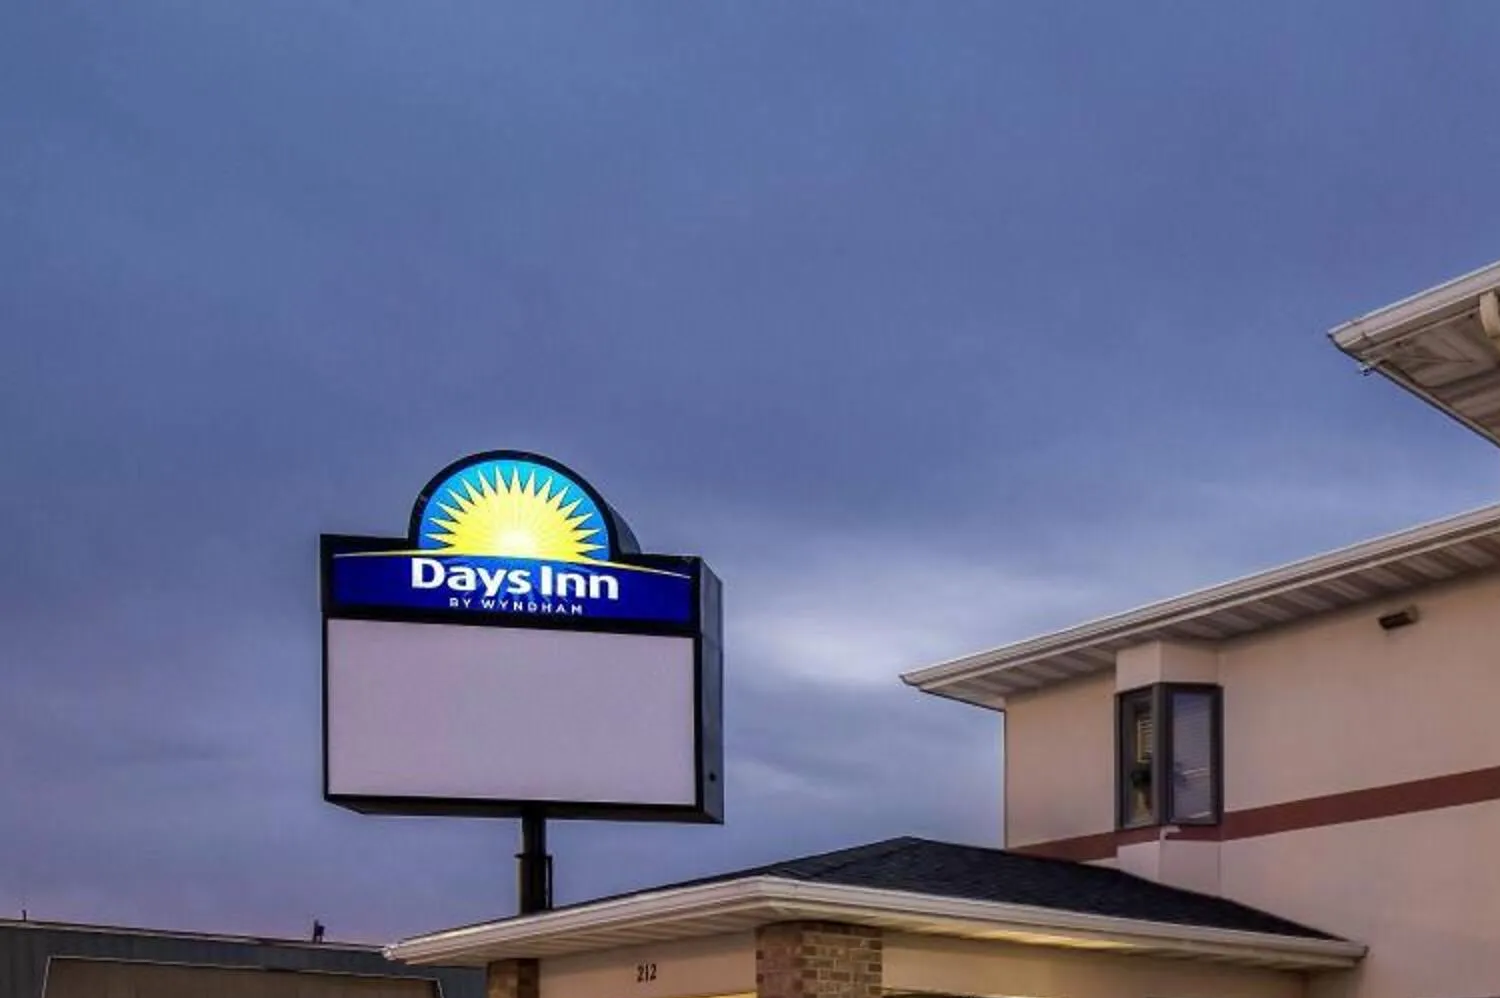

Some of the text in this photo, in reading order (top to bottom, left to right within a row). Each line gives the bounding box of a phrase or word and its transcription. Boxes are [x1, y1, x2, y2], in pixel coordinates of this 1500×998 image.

[411, 557, 619, 600] Days Inn
[449, 597, 583, 614] BY WYNDHAM
[637, 963, 657, 983] 212
